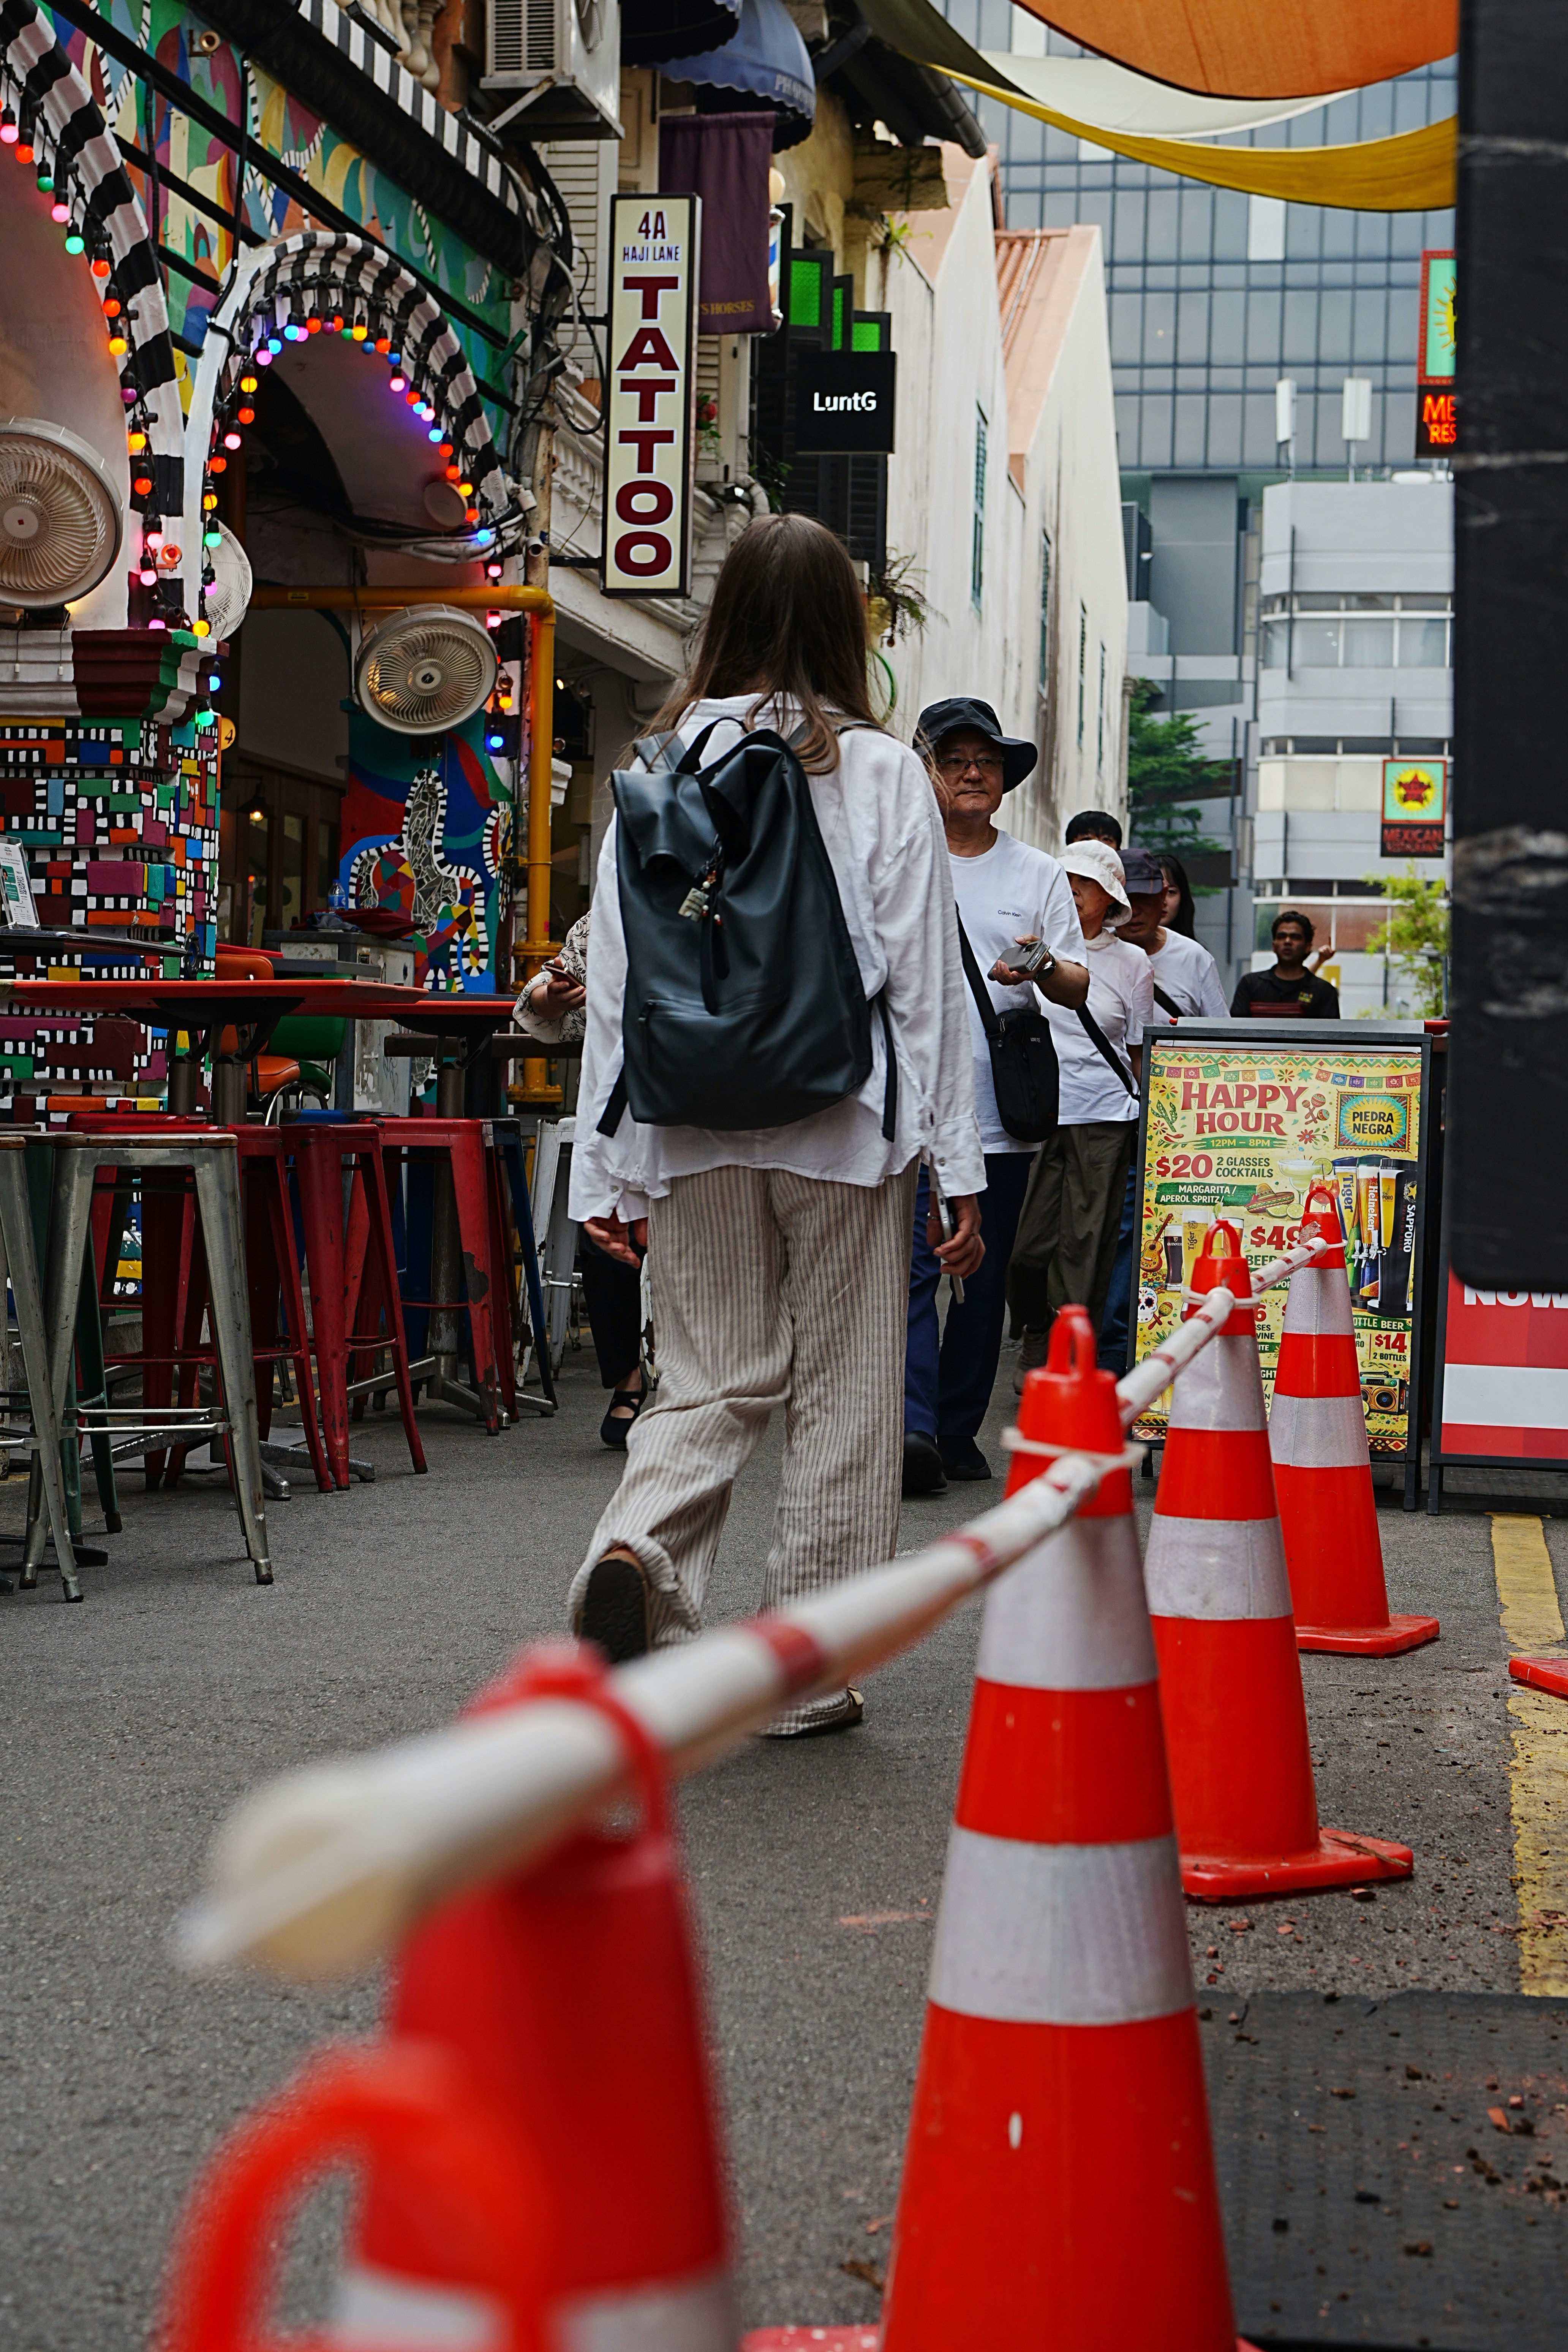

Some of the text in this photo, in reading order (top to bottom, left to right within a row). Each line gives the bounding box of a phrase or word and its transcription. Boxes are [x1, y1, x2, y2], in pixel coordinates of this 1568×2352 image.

[638, 210, 667, 241] 4A
[623, 245, 681, 262] HAJI LANE
[711, 300, 756, 315] HORSES
[613, 276, 680, 577] TATTOO
[1181, 1081, 1309, 1113] HAPPY
[1196, 1112, 1288, 1136] HOUR
[1353, 1111, 1394, 1123] PIEDRA
[1353, 1123, 1393, 1135] NEGRA
[1156, 1154, 1213, 1178] $20
[1217, 1157, 1270, 1167] 2 GLASSES
[1216, 1168, 1273, 1178] COCKTAILS
[1179, 1185, 1231, 1194] MARGARITA
[1342, 1174, 1353, 1212] Tiger
[1367, 1185, 1378, 1231] Heineken
[1250, 1226, 1301, 1250] $49
[1403, 1204, 1416, 1253] SAPPORO
[1187, 1231, 1197, 1250] Tiger
[1253, 1304, 1267, 1322] 6
[1353, 1317, 1404, 1330] OTTLE BEER
[1375, 1333, 1407, 1353] $14
[1380, 1353, 1407, 1362] BOTTLES
